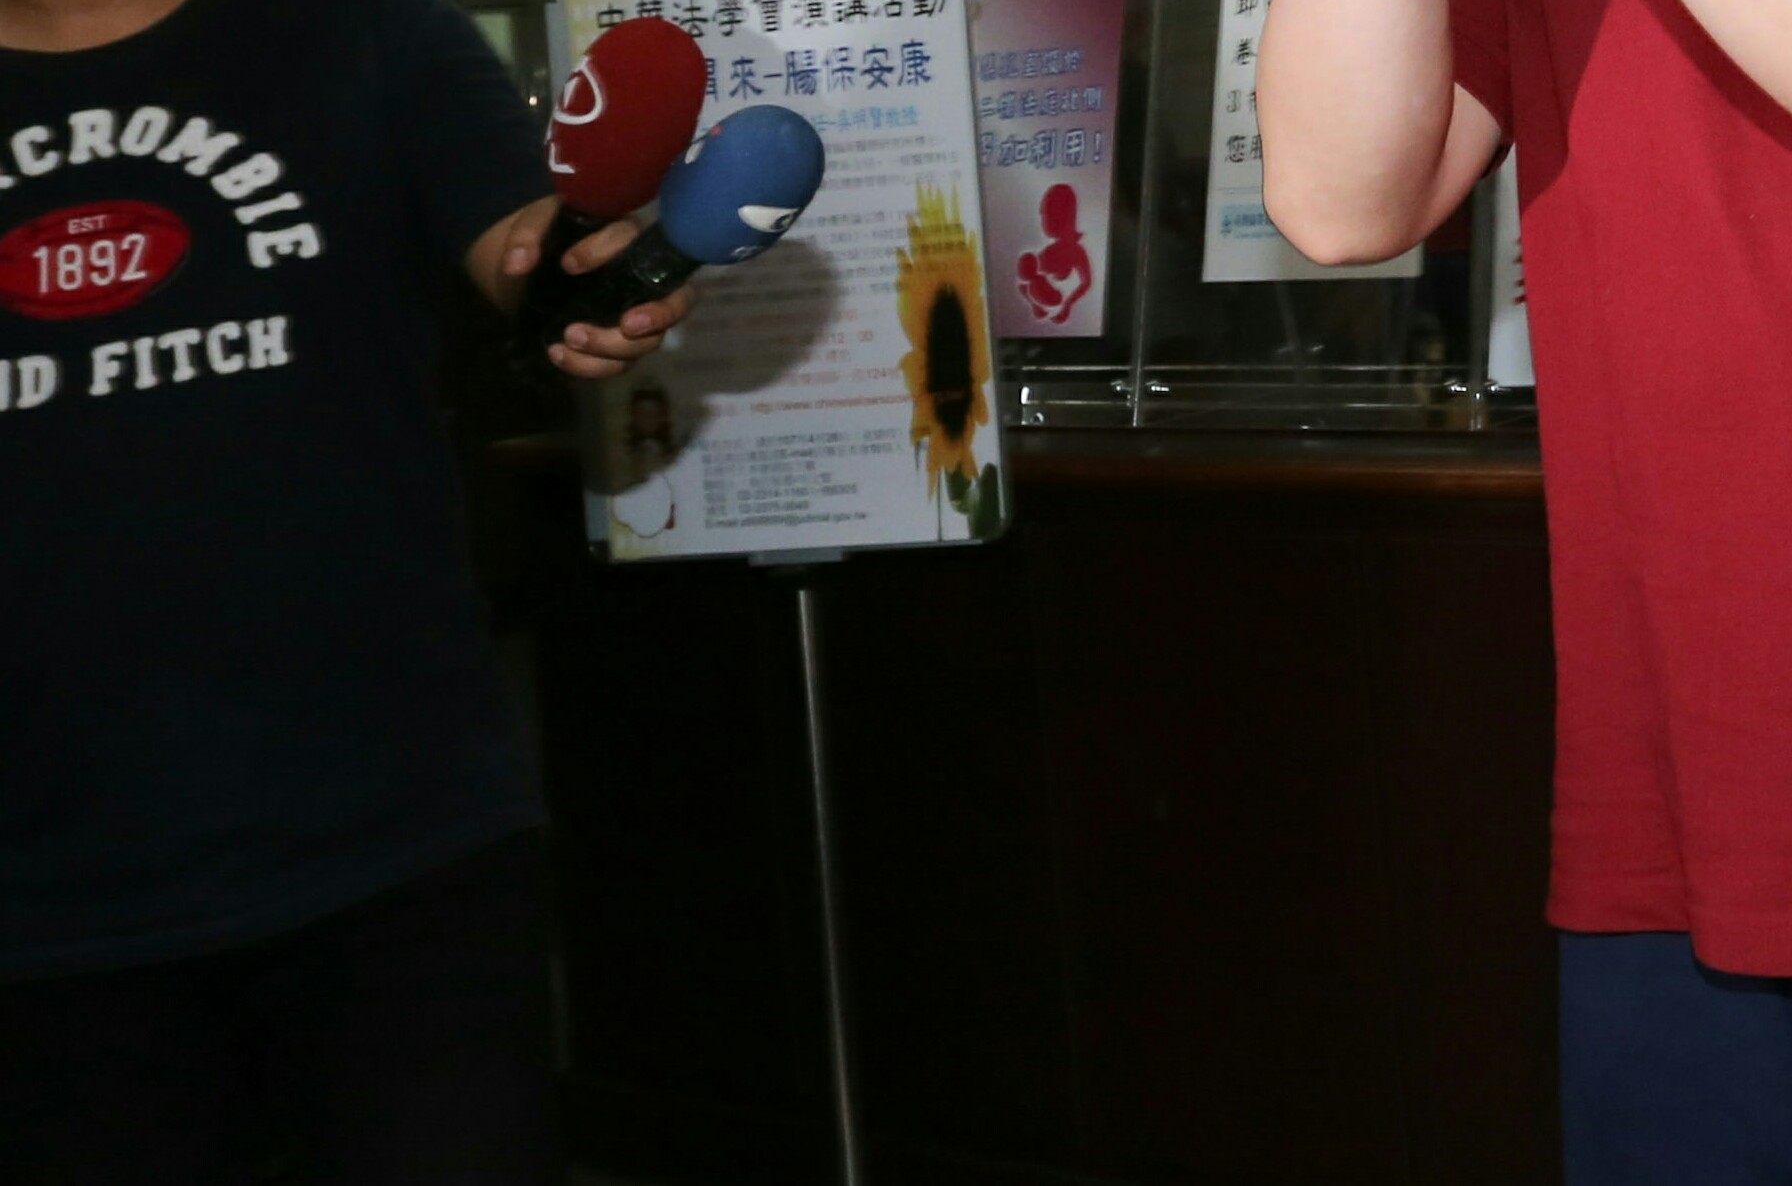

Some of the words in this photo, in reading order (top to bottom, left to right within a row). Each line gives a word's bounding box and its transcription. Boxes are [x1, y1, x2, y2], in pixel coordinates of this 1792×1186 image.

[0, 105, 326, 269] CROMBIE
[67, 214, 108, 235] EST
[31, 233, 149, 294] 1892
[88, 315, 292, 397] FITCH
